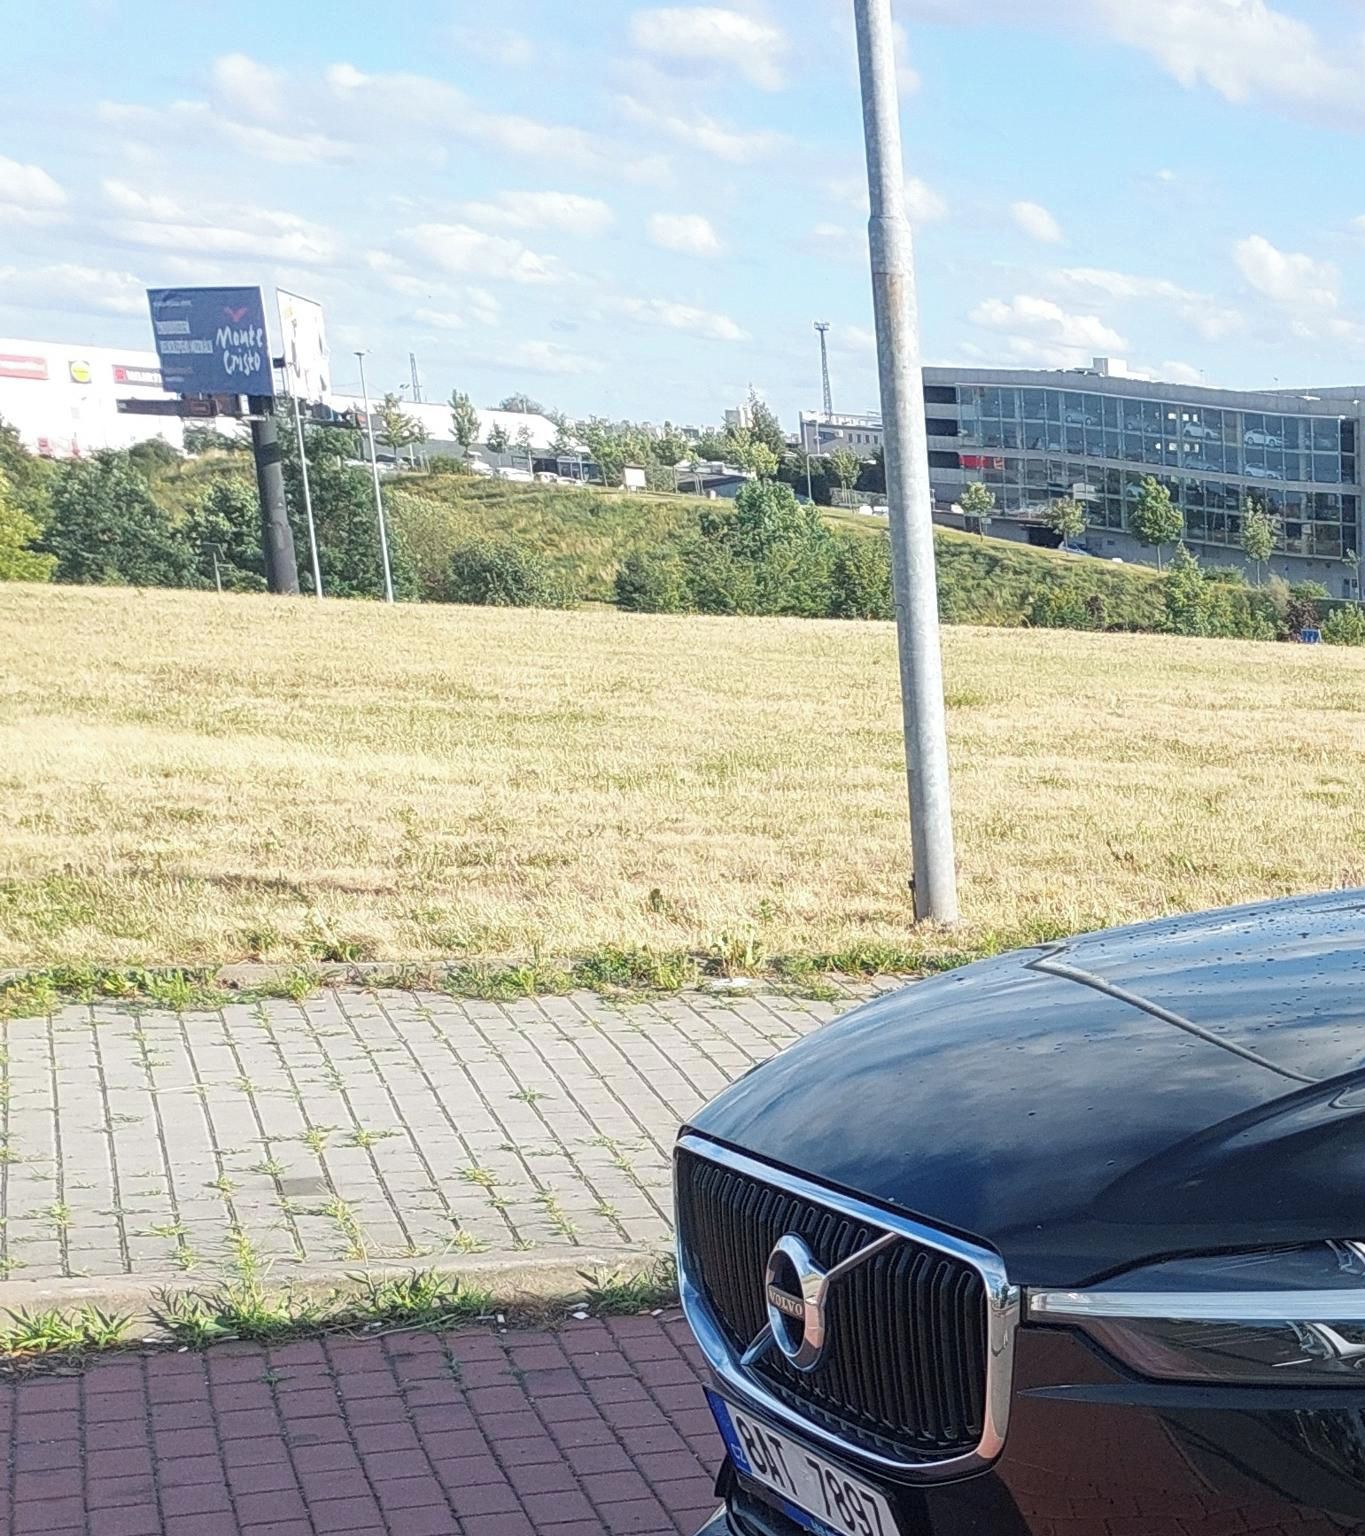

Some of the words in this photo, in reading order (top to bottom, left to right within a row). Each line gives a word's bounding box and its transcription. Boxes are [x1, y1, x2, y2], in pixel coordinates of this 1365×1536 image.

[215, 324, 263, 349] Monte
[223, 349, 260, 376] Cristo
[768, 1289, 803, 1316] VOLVO
[735, 1414, 798, 1497] 8AT
